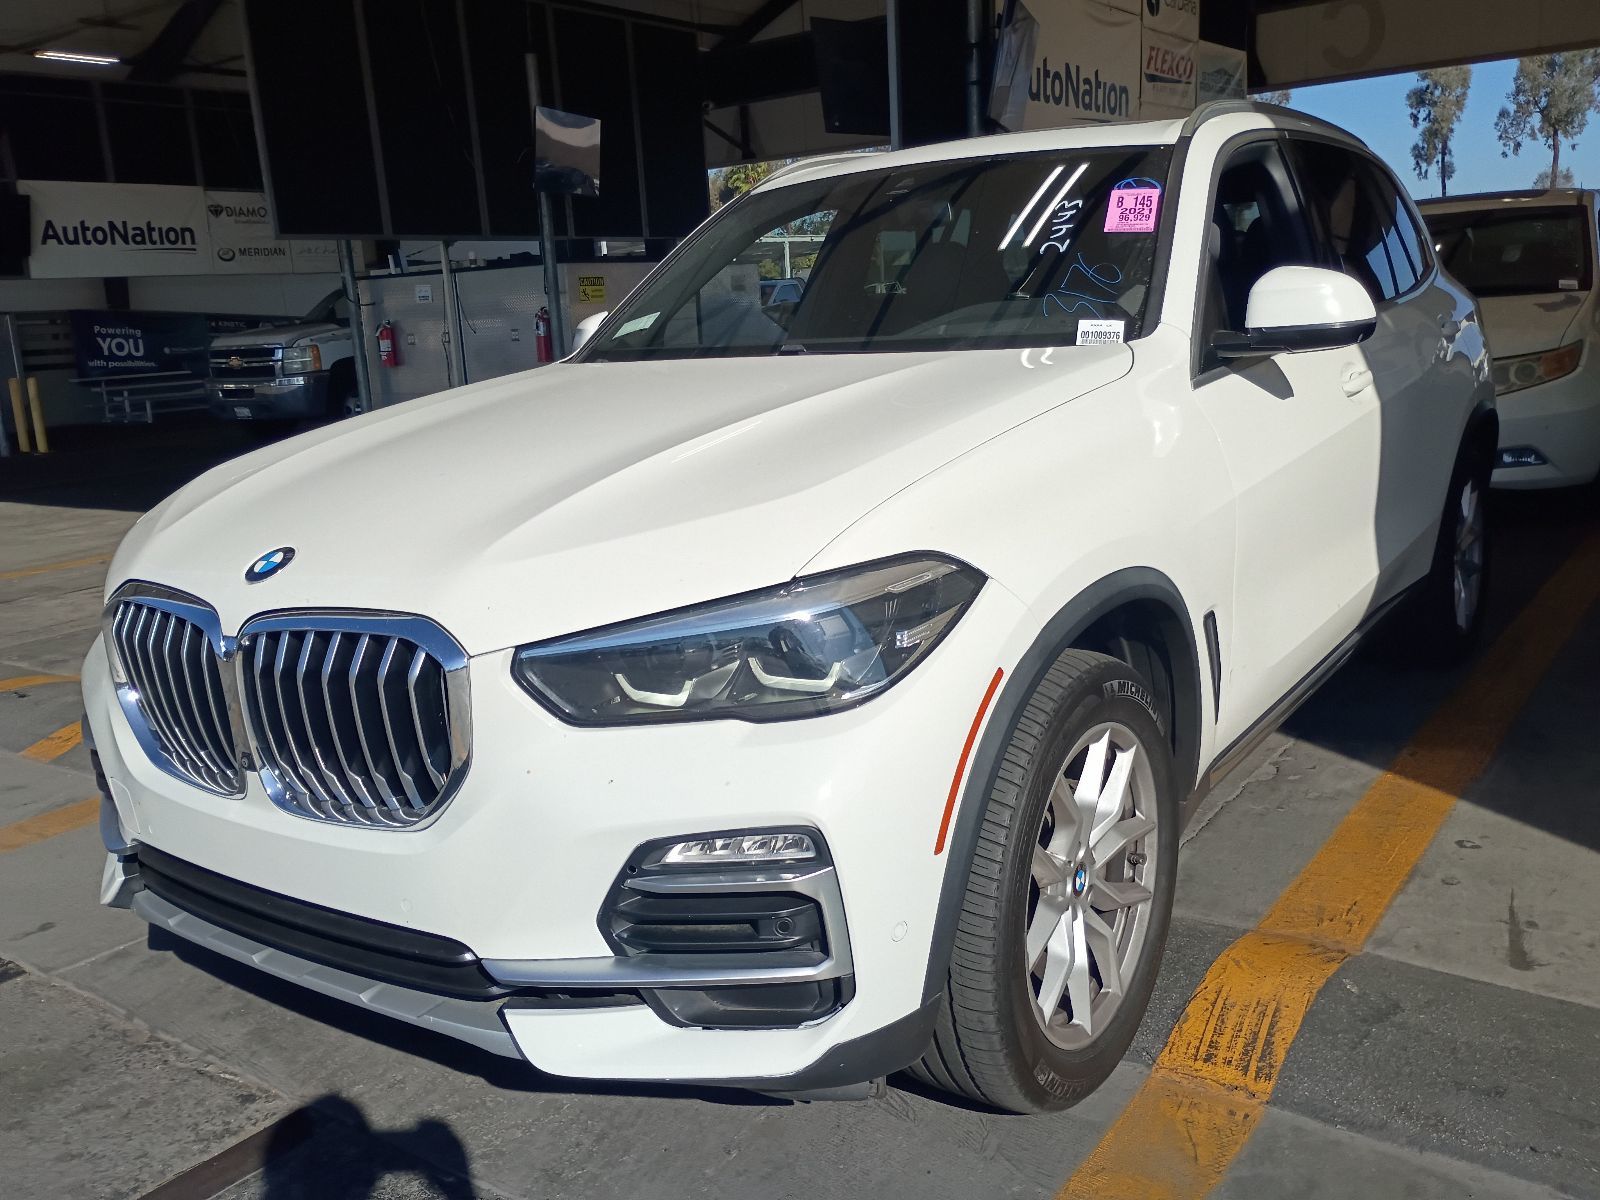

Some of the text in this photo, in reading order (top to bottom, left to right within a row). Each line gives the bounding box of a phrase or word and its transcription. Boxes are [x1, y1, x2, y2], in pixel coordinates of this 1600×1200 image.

[1146, 46, 1194, 80] FLEXCO
[1116, 195, 1153, 208] B 145
[41, 219, 196, 246] AutoNation
[238, 247, 286, 257] MERIDIAN
[580, 277, 605, 286] CAUTION
[93, 325, 142, 338] Powering
[96, 338, 144, 357] YOU
[88, 359, 107, 368] with
[1117, 680, 1159, 720] MICHELIN
